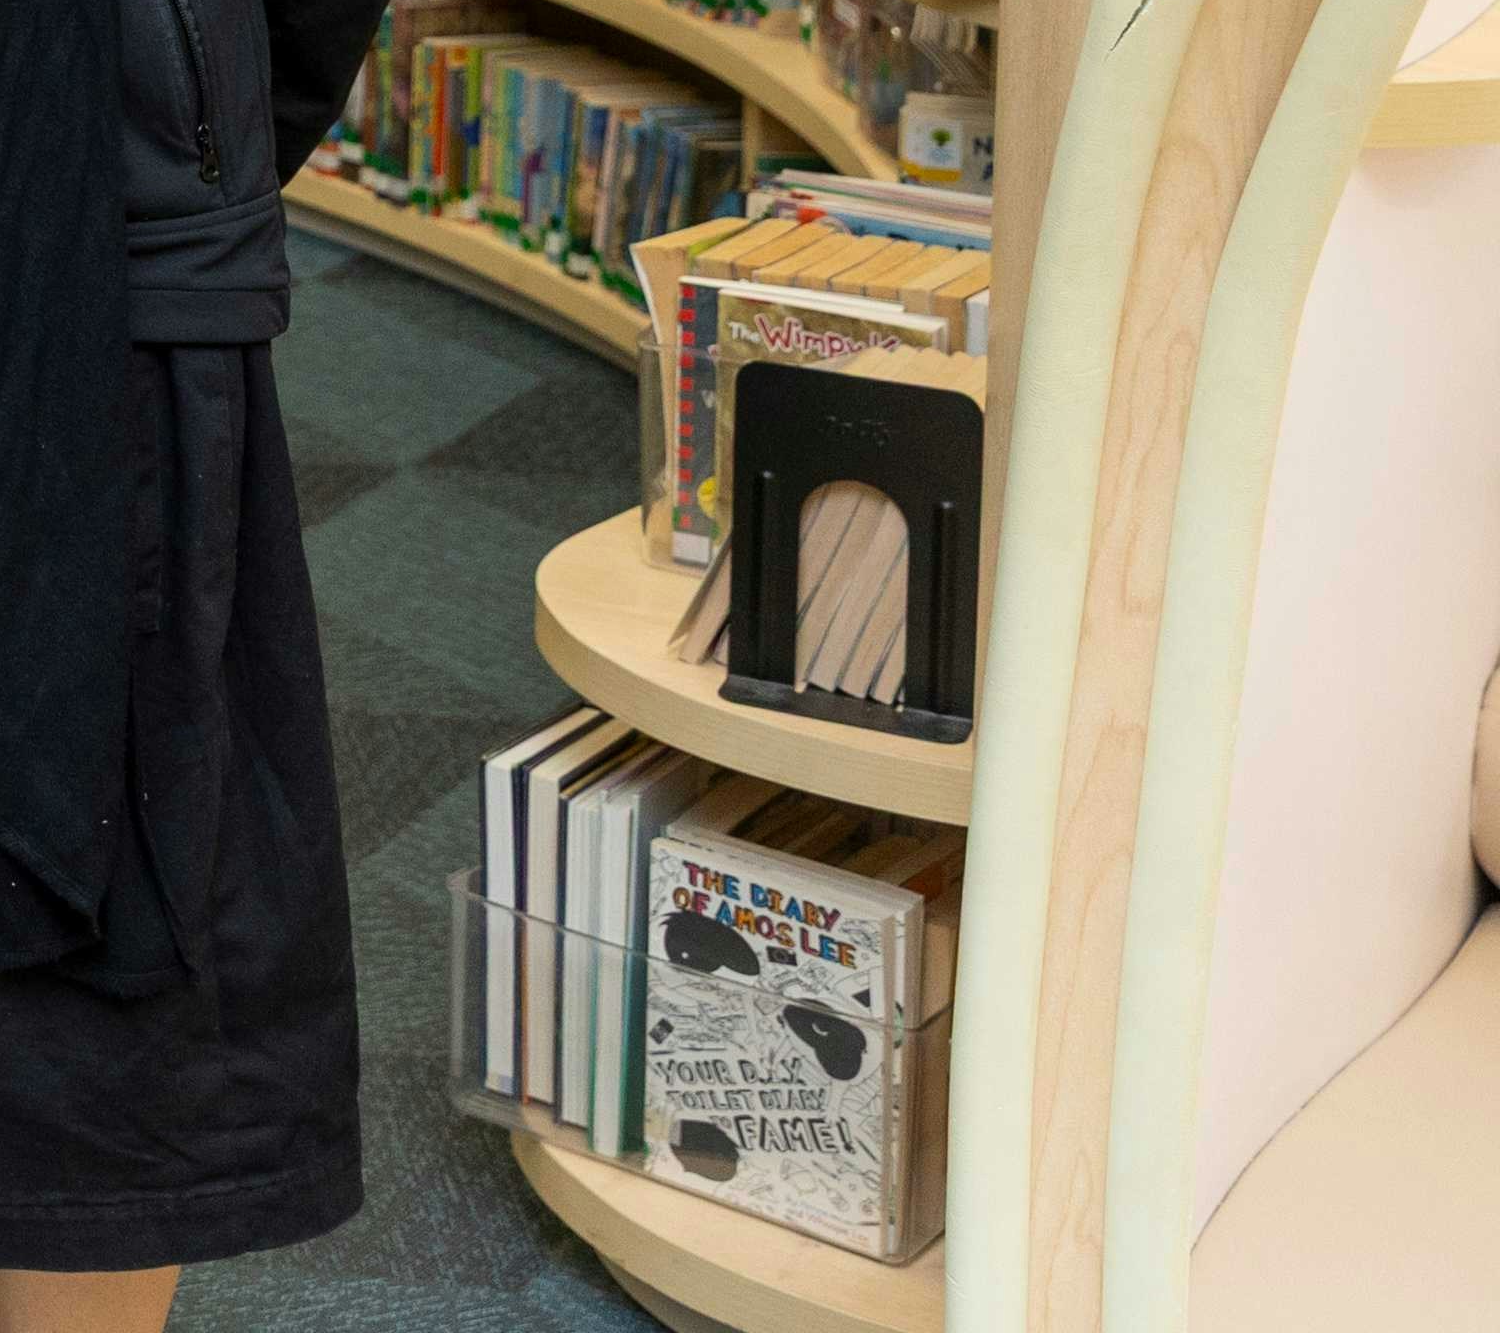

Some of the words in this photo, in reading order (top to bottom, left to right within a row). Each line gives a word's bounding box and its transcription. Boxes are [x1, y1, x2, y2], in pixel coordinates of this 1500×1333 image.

[728, 320, 761, 343] The
[682, 859, 741, 901] THE
[750, 882, 841, 932] DIARY
[672, 886, 712, 916] OF
[715, 899, 796, 949] AMOS
[799, 926, 858, 970] LEE
[653, 1058, 737, 1086] YOUR
[665, 1087, 758, 1111] TOILET
[758, 1087, 826, 1112] DIARY
[732, 1113, 857, 1155] FAME!
